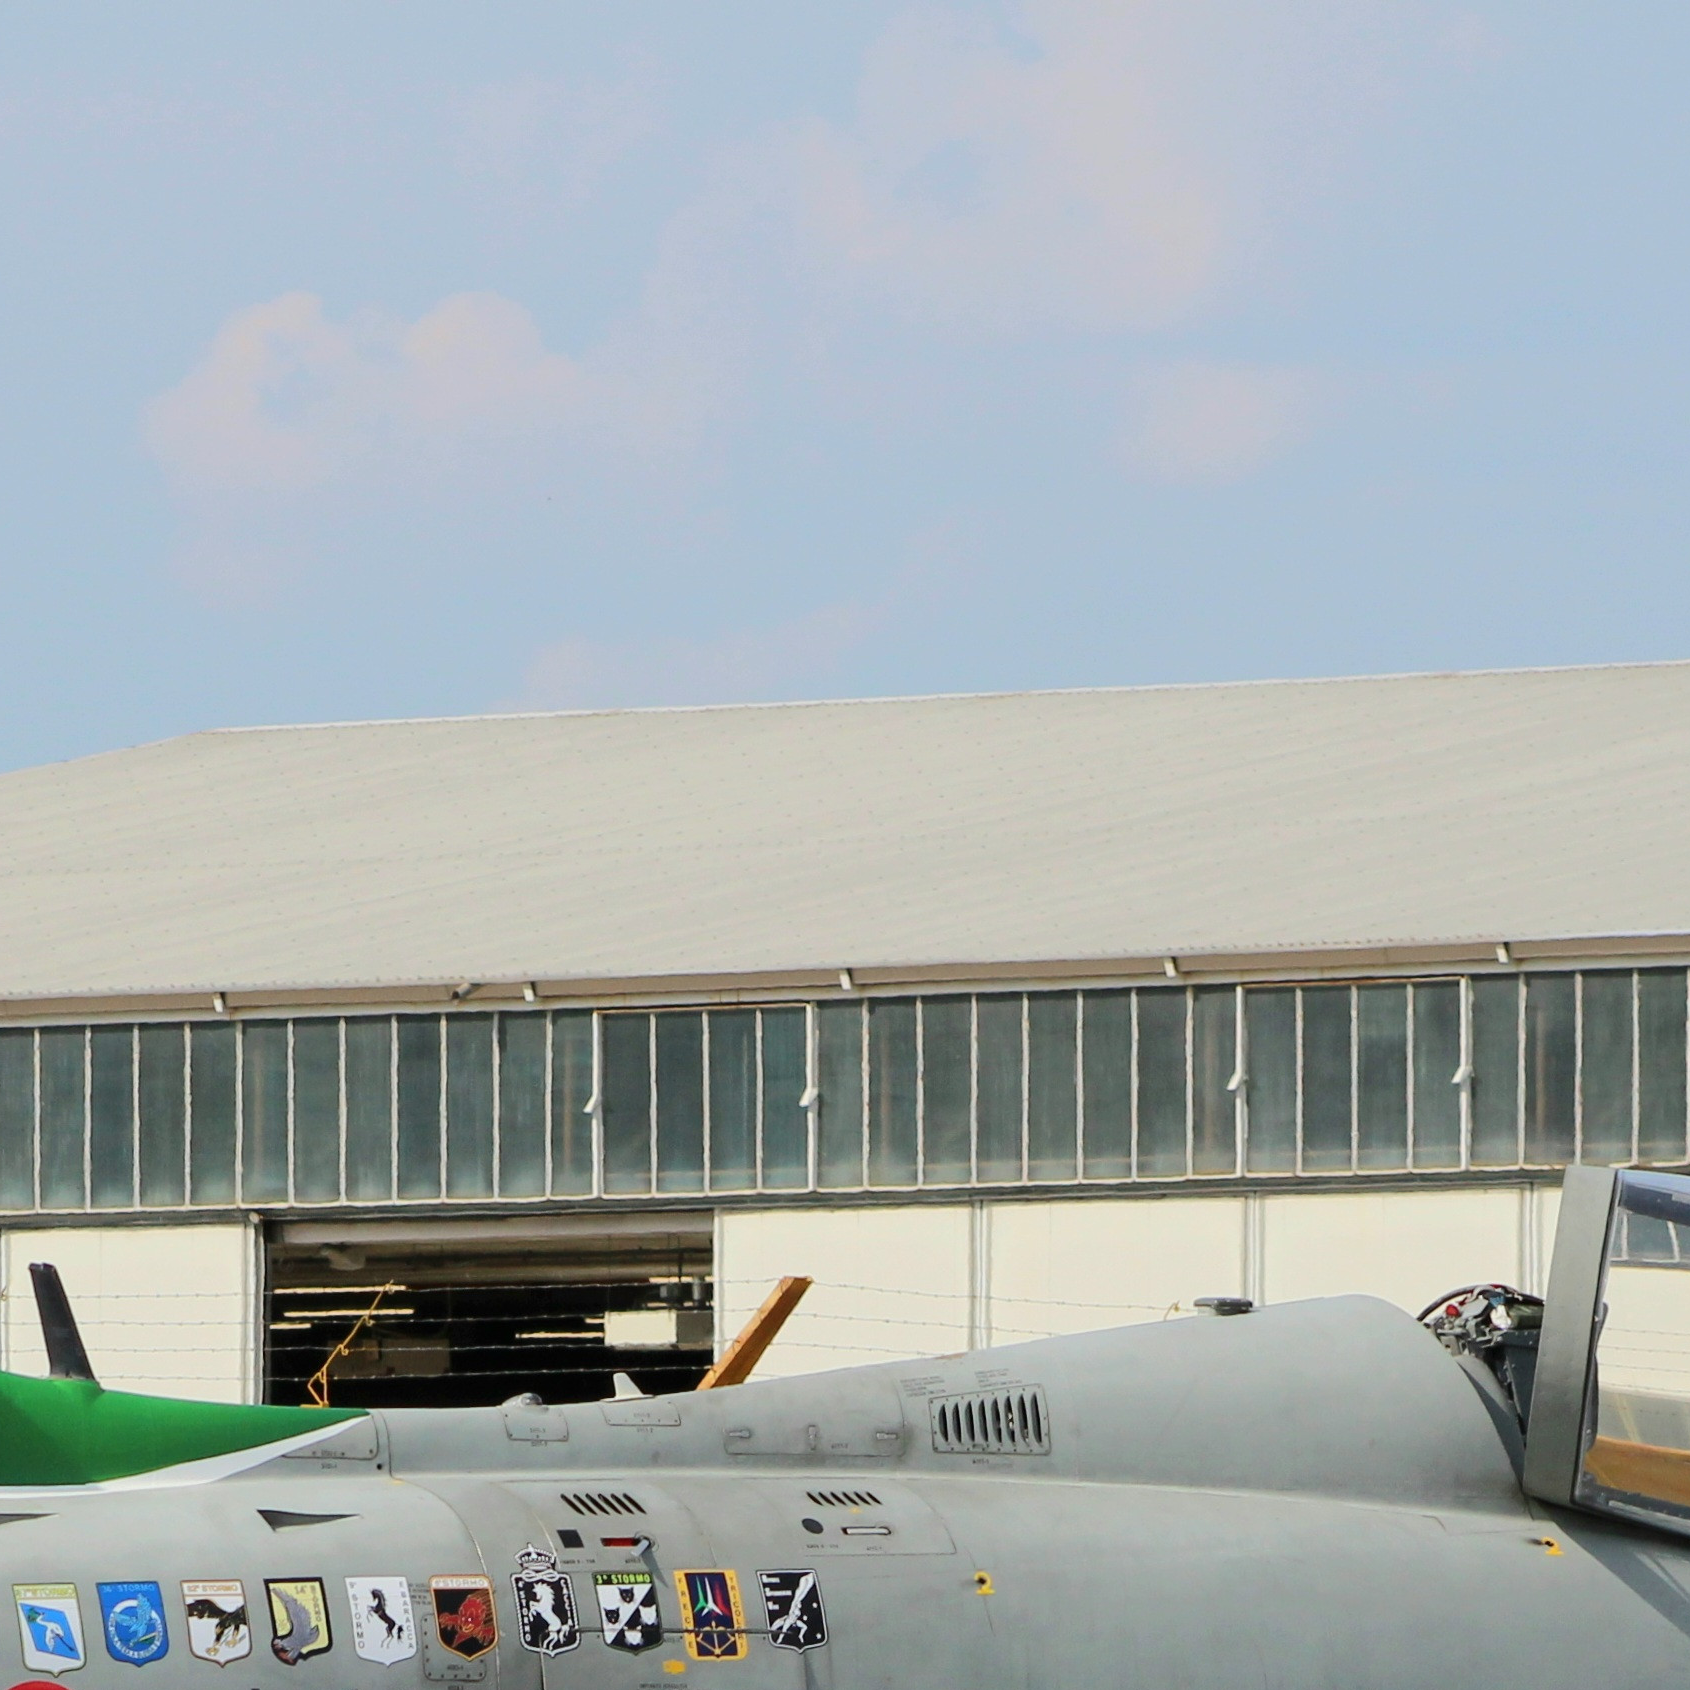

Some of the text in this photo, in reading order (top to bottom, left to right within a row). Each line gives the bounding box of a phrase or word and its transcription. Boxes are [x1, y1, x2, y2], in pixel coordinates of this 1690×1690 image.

[444, 1578, 486, 1587] STORMO
[611, 1573, 651, 1584] STORMO
[117, 1583, 155, 1593] STORMO
[202, 1584, 238, 1593] STORMO
[518, 1589, 532, 1642] STORMO
[351, 1593, 365, 1650] STORMO
